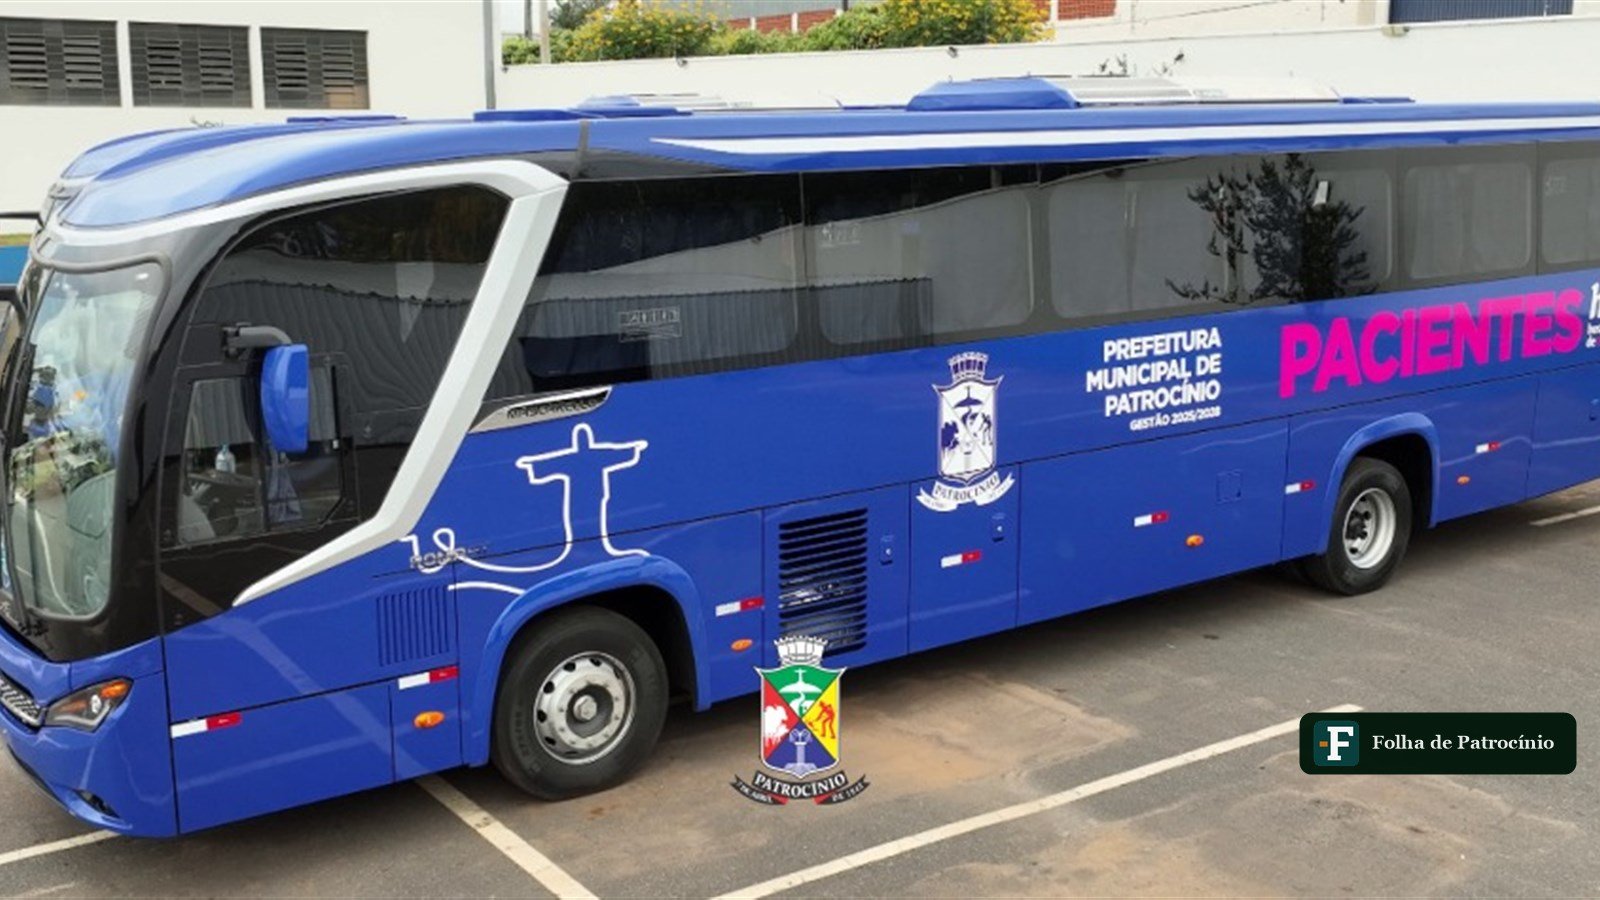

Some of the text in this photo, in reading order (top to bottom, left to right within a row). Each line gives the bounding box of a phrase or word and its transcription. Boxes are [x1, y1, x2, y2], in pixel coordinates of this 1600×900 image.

[1103, 327, 1222, 363] PREFEITURA
[1279, 288, 1584, 399] PACIENTES
[1086, 353, 1222, 393] MUNICIPAL DE
[1105, 377, 1222, 417] PATROCÍNIO
[1129, 412, 1170, 431] GESTÃO
